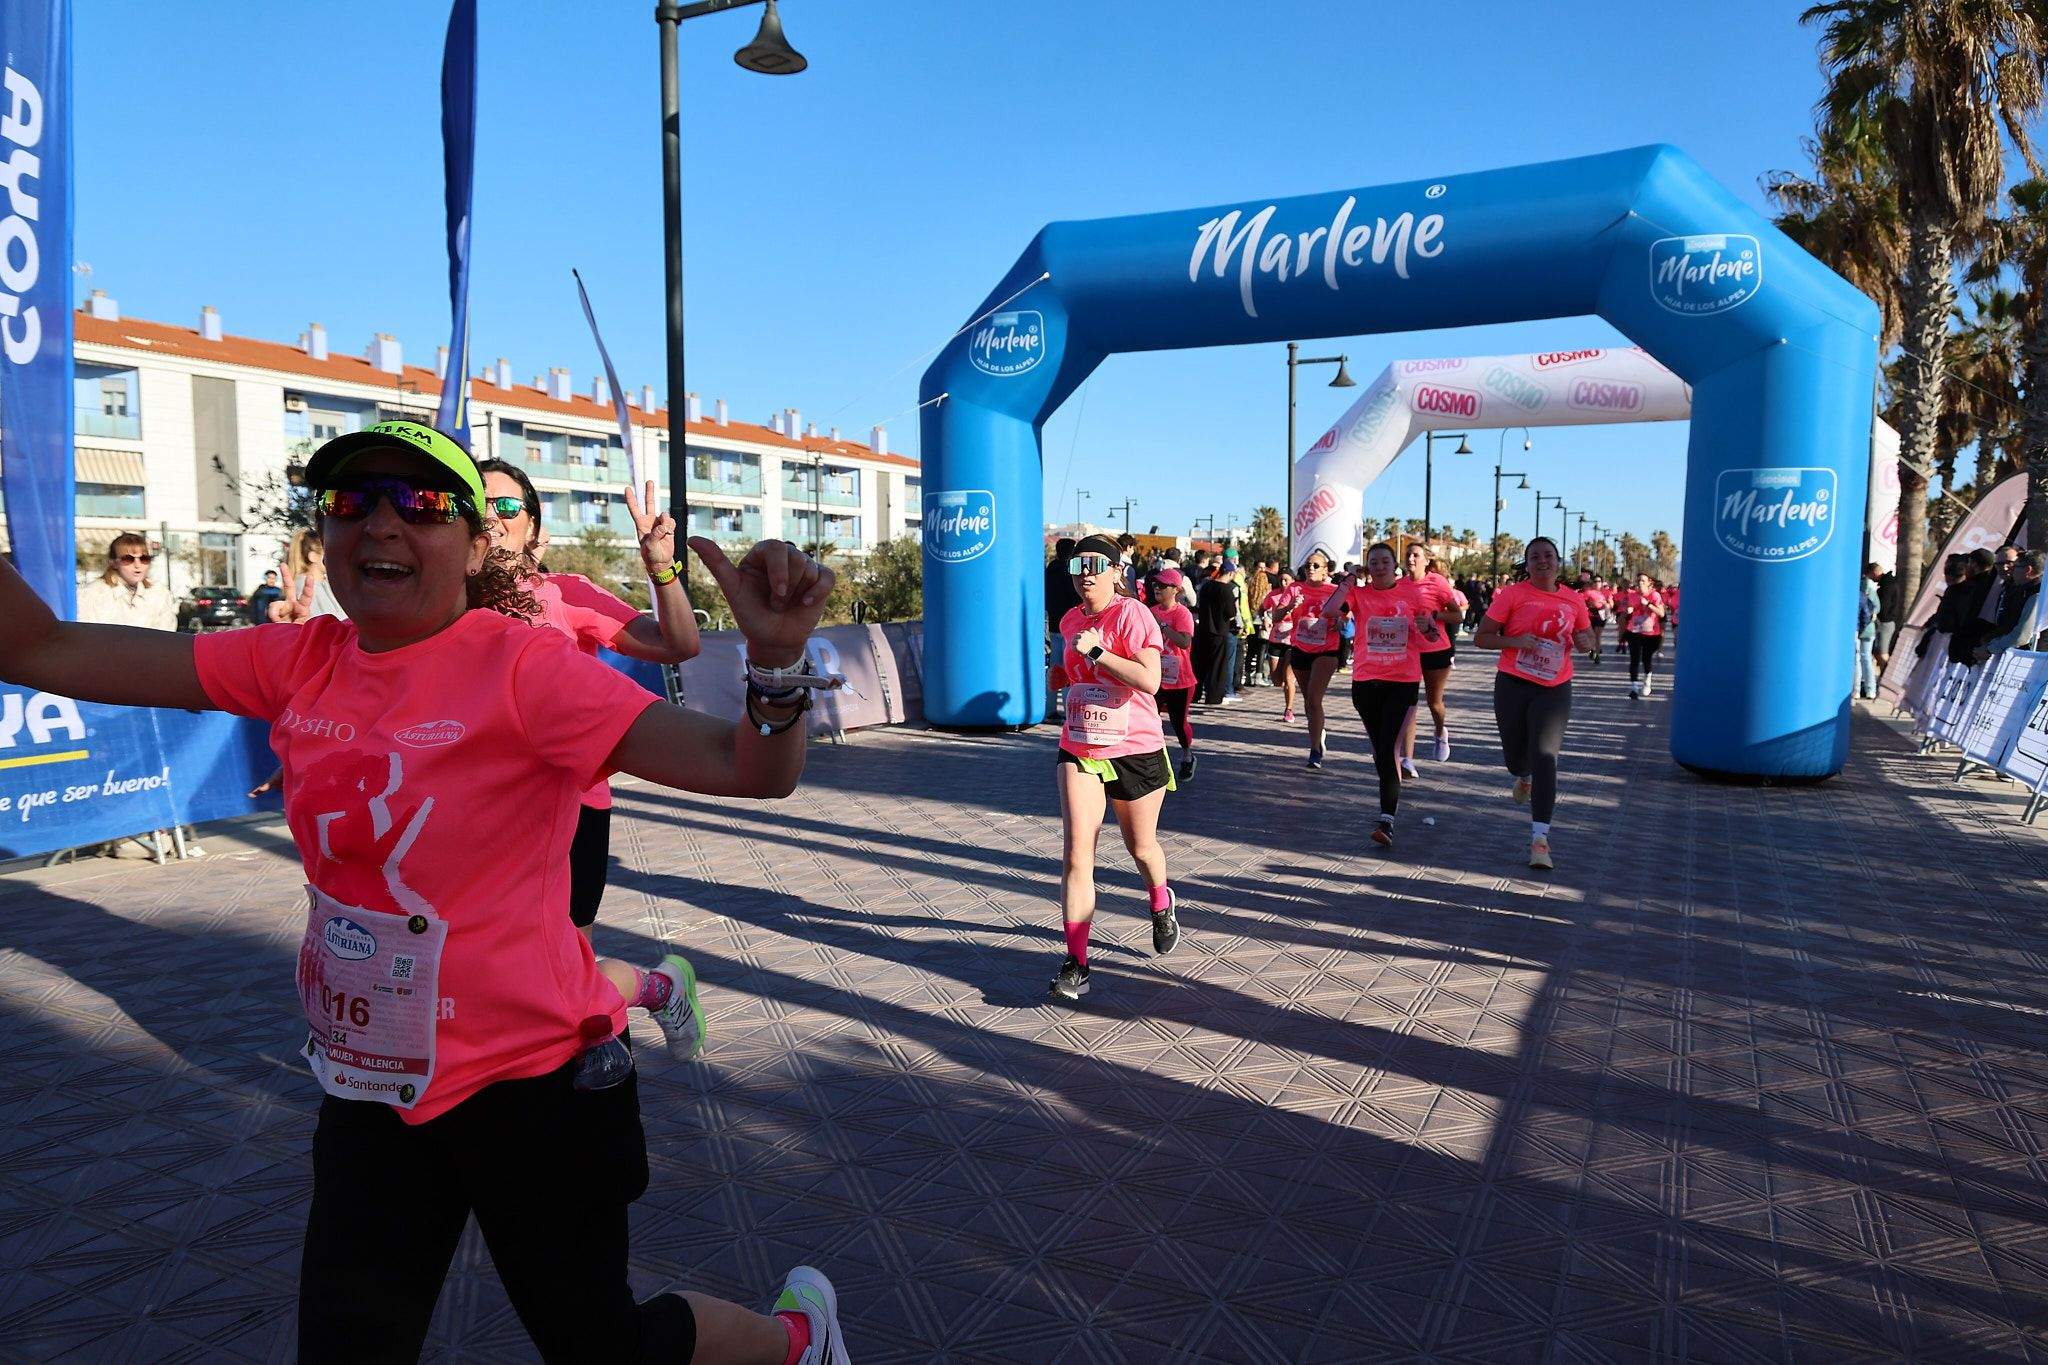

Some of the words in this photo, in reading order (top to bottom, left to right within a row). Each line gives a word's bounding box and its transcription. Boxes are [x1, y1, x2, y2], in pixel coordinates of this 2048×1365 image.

[1189, 196, 1445, 317] Marlene
[1658, 251, 1754, 295] Marlene
[1697, 302, 1716, 311] LOS
[1718, 288, 1746, 307] ALPES
[974, 326, 1039, 359] Marlene
[1538, 349, 1600, 366] COSMO
[1417, 387, 1476, 417] COSMO
[1574, 381, 1639, 410] COSMO
[926, 506, 990, 543] Marlene
[1721, 488, 1828, 536] Marlene
[948, 550, 962, 558] LOS
[963, 541, 984, 556] ALPES
[1746, 545, 1761, 555] DE
[1763, 546, 1785, 556] LOS
[1786, 536, 1819, 555] ALPES
[1084, 710, 1108, 721] 016
[18, 789, 57, 822] que
[62, 783, 98, 803] ser
[102, 766, 170, 796] bueno!
[322, 984, 370, 1027] 016
[360, 1056, 405, 1070] VALENCIA
[347, 1076, 403, 1093] Santande
